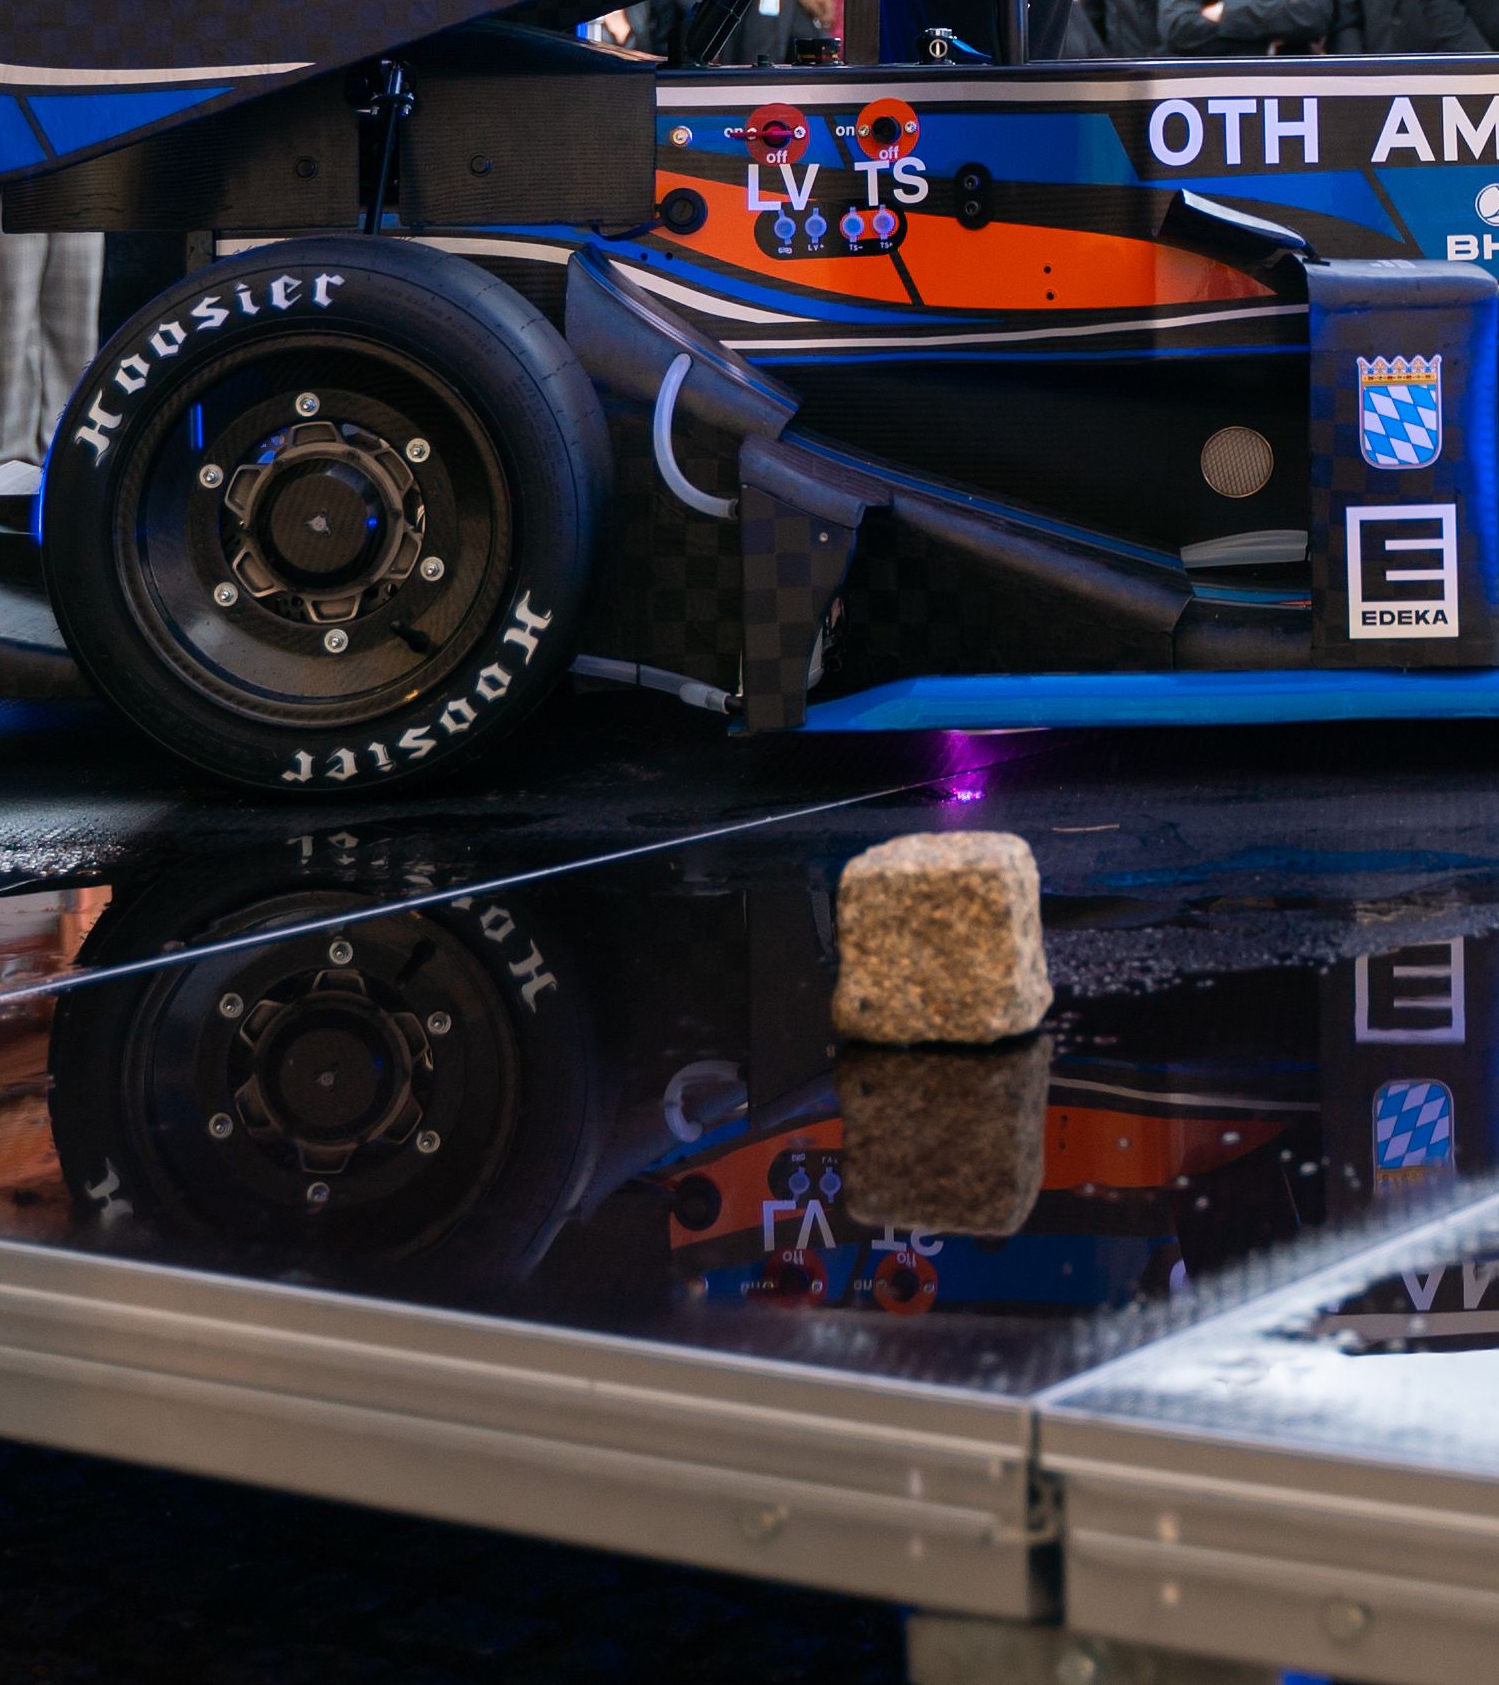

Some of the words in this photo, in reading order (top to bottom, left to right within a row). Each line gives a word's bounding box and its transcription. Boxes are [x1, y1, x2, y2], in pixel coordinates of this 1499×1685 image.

[835, 123, 856, 137] on
[878, 145, 901, 161] off
[1147, 98, 1320, 166] OTH
[766, 149, 789, 164] off
[854, 155, 929, 207] TS
[746, 163, 820, 212] LV
[73, 267, 348, 468] Hoosier
[1361, 609, 1449, 625] EDEKA
[281, 590, 555, 787] Hoosier
